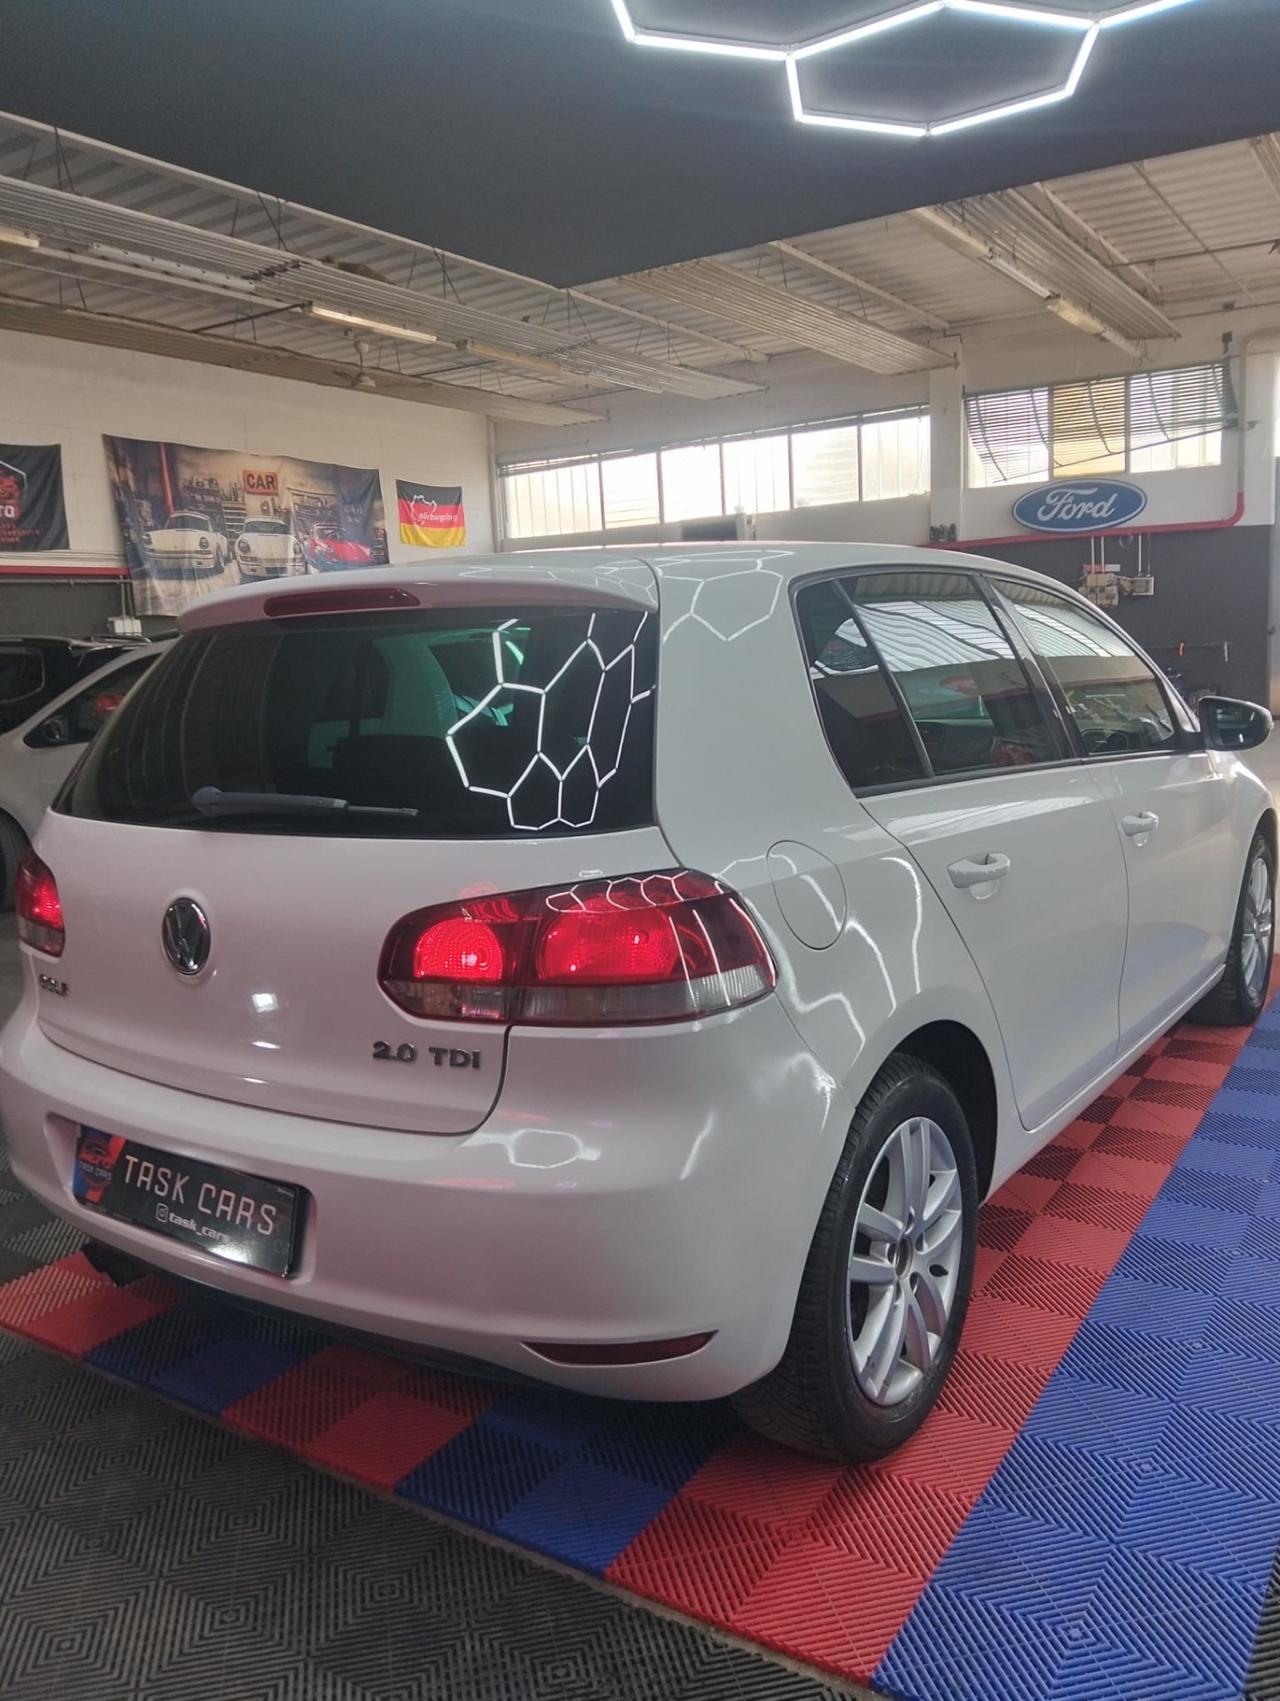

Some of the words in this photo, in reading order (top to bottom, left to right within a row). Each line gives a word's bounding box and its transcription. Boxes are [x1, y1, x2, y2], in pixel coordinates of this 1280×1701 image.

[246, 473, 276, 490] CAR
[1037, 487, 1119, 522] Ford
[372, 1040, 417, 1064] 2.0
[429, 1046, 481, 1069] TDI
[125, 1154, 190, 1204] TASK
[197, 1182, 276, 1236] CARS
